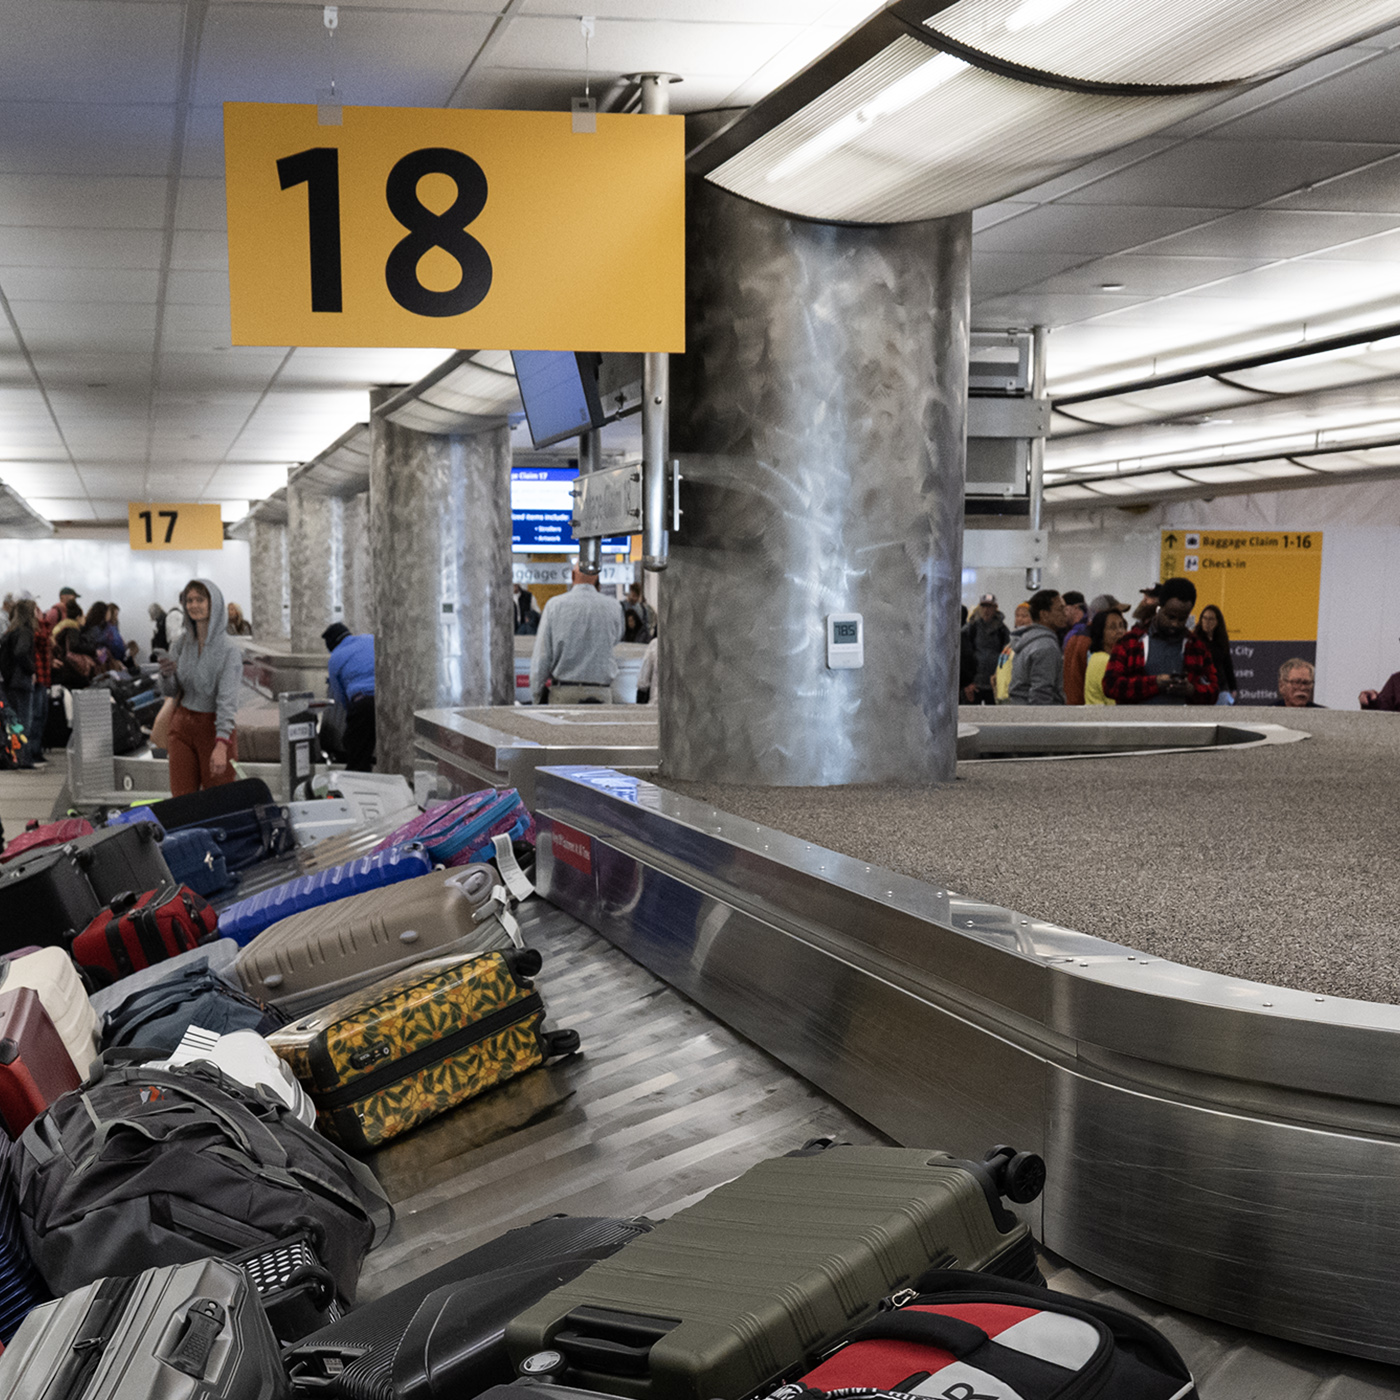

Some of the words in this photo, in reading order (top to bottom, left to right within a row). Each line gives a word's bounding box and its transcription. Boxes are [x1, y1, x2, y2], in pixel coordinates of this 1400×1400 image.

[276, 147, 492, 318] 18
[138, 511, 178, 544] 17
[1203, 536, 1247, 549] Baggage
[1249, 535, 1278, 546] Claim
[1283, 535, 1312, 549] 1-16
[1202, 558, 1247, 569] Check-in
[515, 568, 558, 584] ggage
[604, 568, 615, 579] 17
[1235, 645, 1254, 658] City
[1234, 669, 1254, 678] uses
